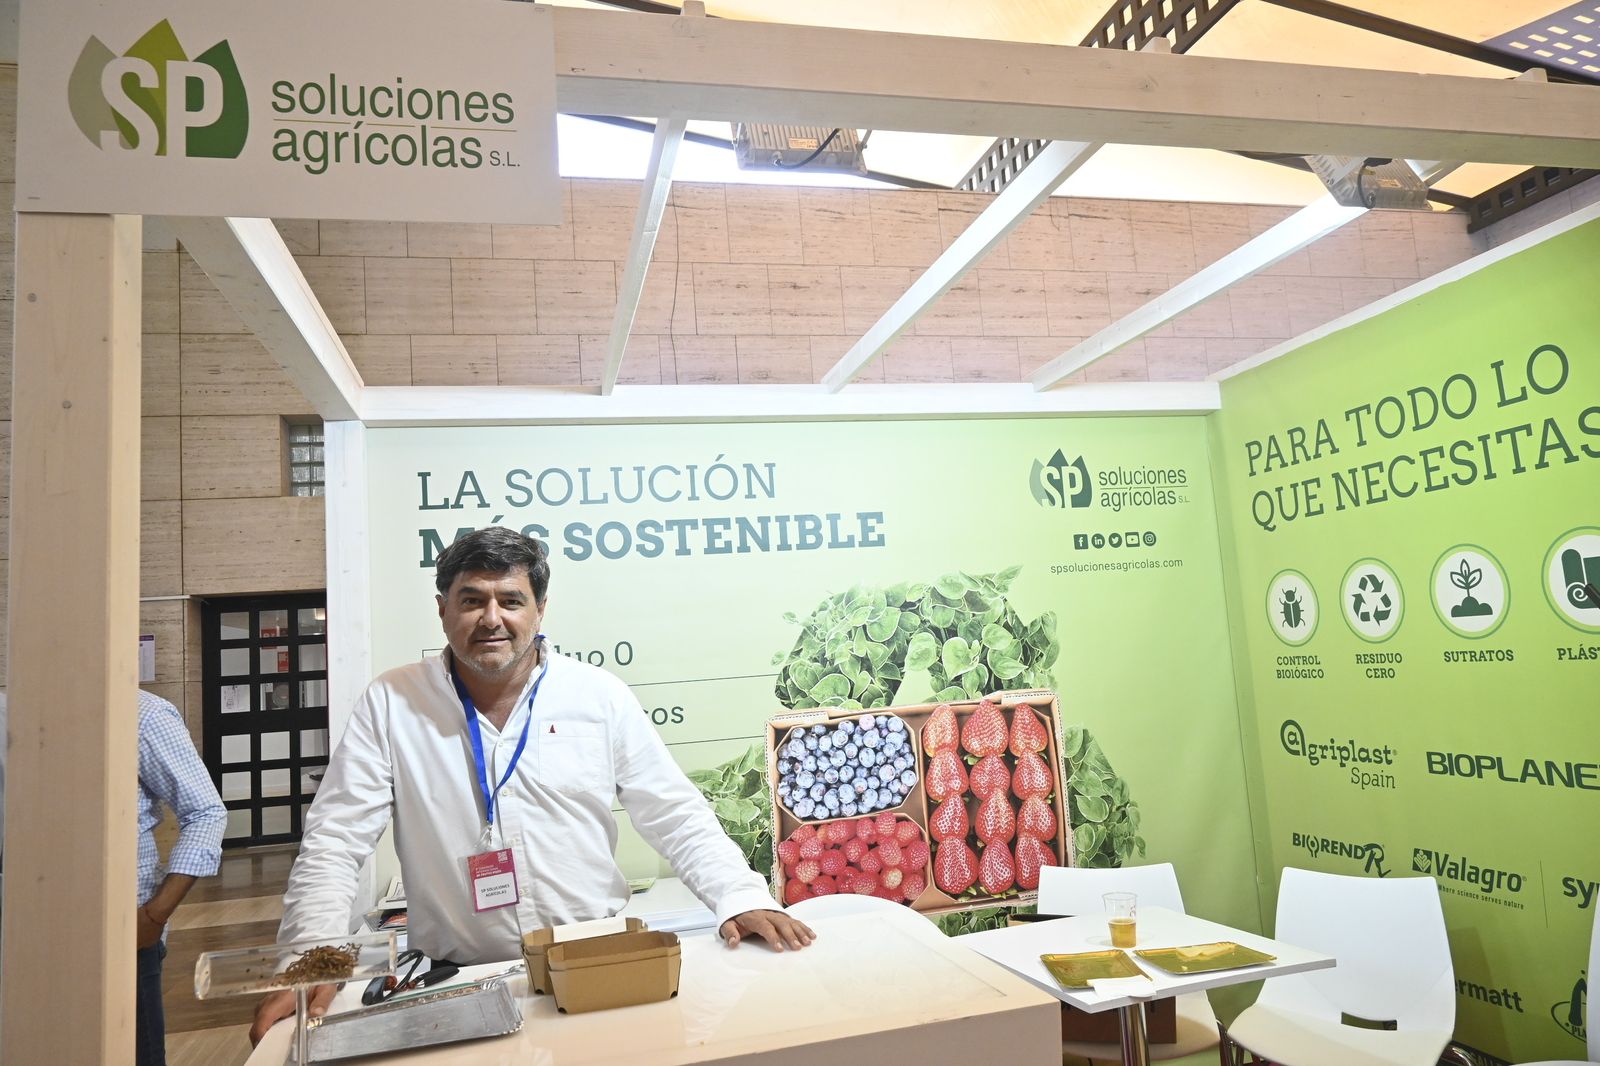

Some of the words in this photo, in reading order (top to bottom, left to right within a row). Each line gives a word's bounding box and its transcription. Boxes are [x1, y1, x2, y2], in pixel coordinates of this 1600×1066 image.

[271, 73, 515, 124] soluciones
[272, 121, 483, 175] agrícolas
[488, 150, 521, 167] S.L.
[1245, 418, 1340, 477] PARA
[1344, 373, 1477, 447] TODO
[1490, 343, 1569, 408] LO
[1099, 466, 1187, 485] soluciones
[1252, 477, 1324, 532] QUE
[1331, 405, 1600, 511] NECESITAS
[417, 470, 491, 511] LA
[504, 454, 777, 508] SOLUCIÓN
[1100, 487, 1177, 512] agrícolas
[563, 511, 886, 562] SOSTENIBLE
[1050, 559, 1183, 575] spsolucionesagricolas.com
[1276, 655, 1321, 666] CONTROL
[1355, 652, 1403, 665] RESIDUO
[1443, 649, 1515, 663] SUTRATOS
[1556, 643, 1600, 661] PLÁS
[1365, 667, 1396, 679] CERO
[1350, 767, 1396, 790] Spain
[1426, 751, 1600, 791] BIOPLANE
[1434, 852, 1523, 894] Valagro
[1457, 889, 1480, 900] science
[1481, 895, 1502, 905] serves
[1503, 900, 1525, 910] nature
[1455, 979, 1524, 1013] rmatt
